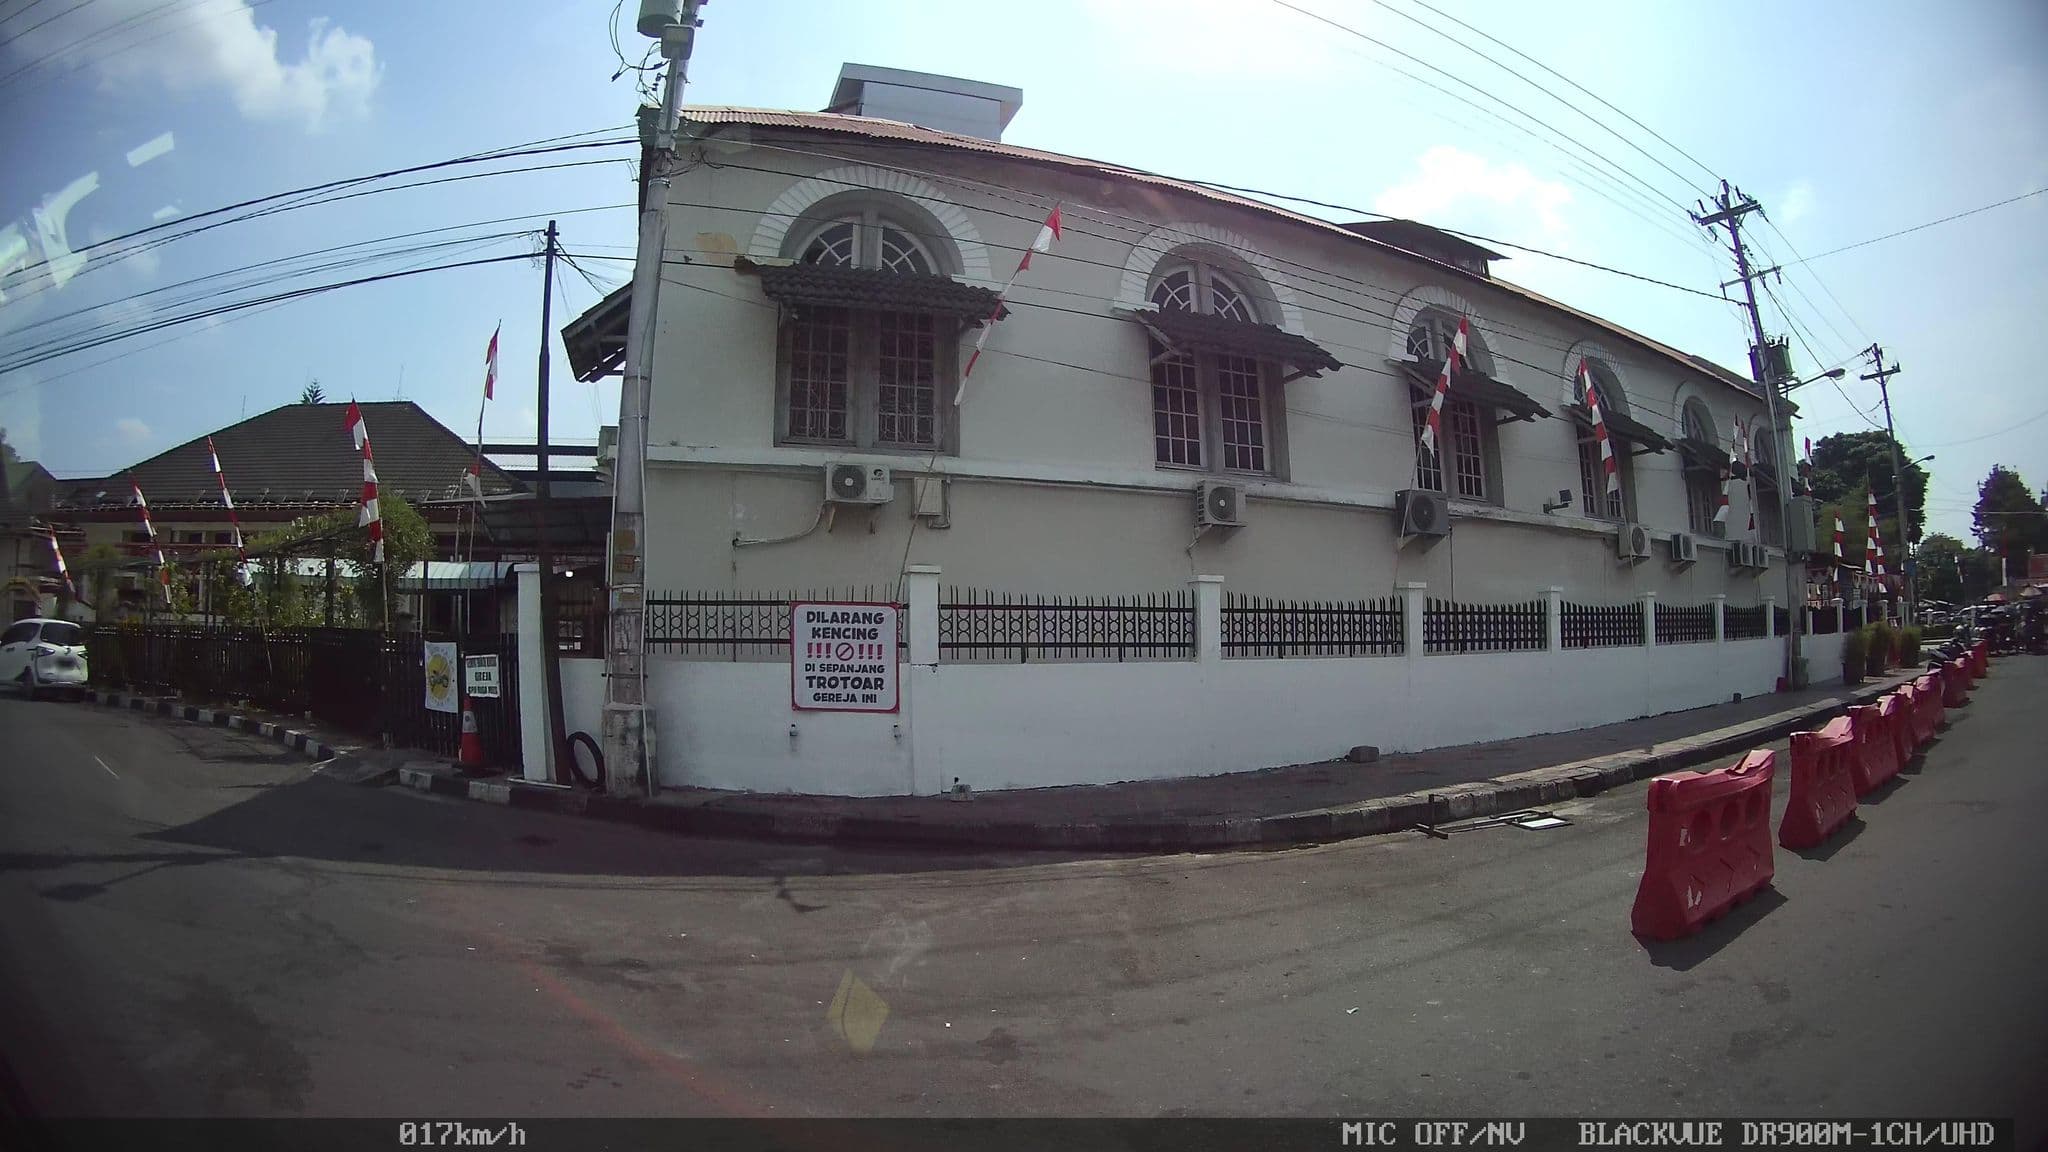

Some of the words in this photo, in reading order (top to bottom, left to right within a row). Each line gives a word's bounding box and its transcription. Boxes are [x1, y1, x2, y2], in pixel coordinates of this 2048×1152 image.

[806, 611, 885, 625] DILARANG
[811, 627, 879, 640] KENCING
[805, 663, 815, 672] DI
[819, 663, 885, 674] SEPANJANG
[805, 676, 885, 691] TROTOAR
[813, 692, 858, 703] GEREJA
[861, 693, 877, 704] INI
